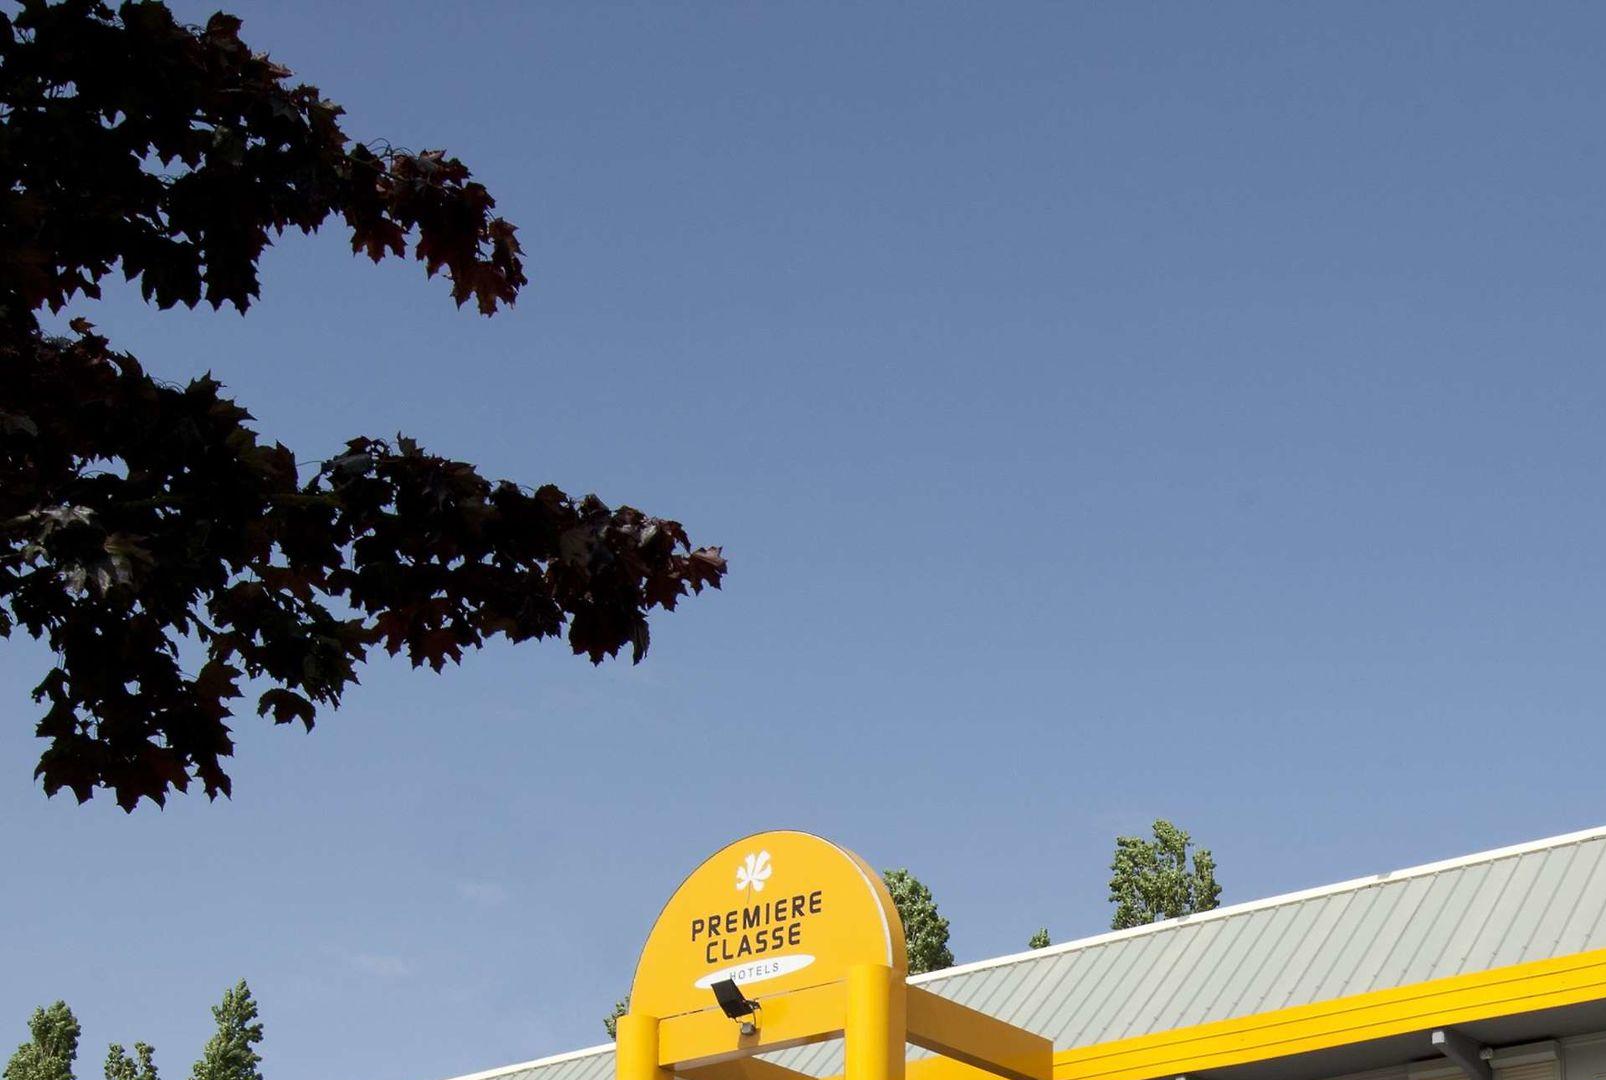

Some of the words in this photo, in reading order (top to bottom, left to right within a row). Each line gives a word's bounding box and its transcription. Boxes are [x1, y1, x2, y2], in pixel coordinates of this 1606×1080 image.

[691, 890, 823, 942] PREMIERE
[706, 922, 801, 964] CLASSE
[729, 962, 780, 981] HOTELS
